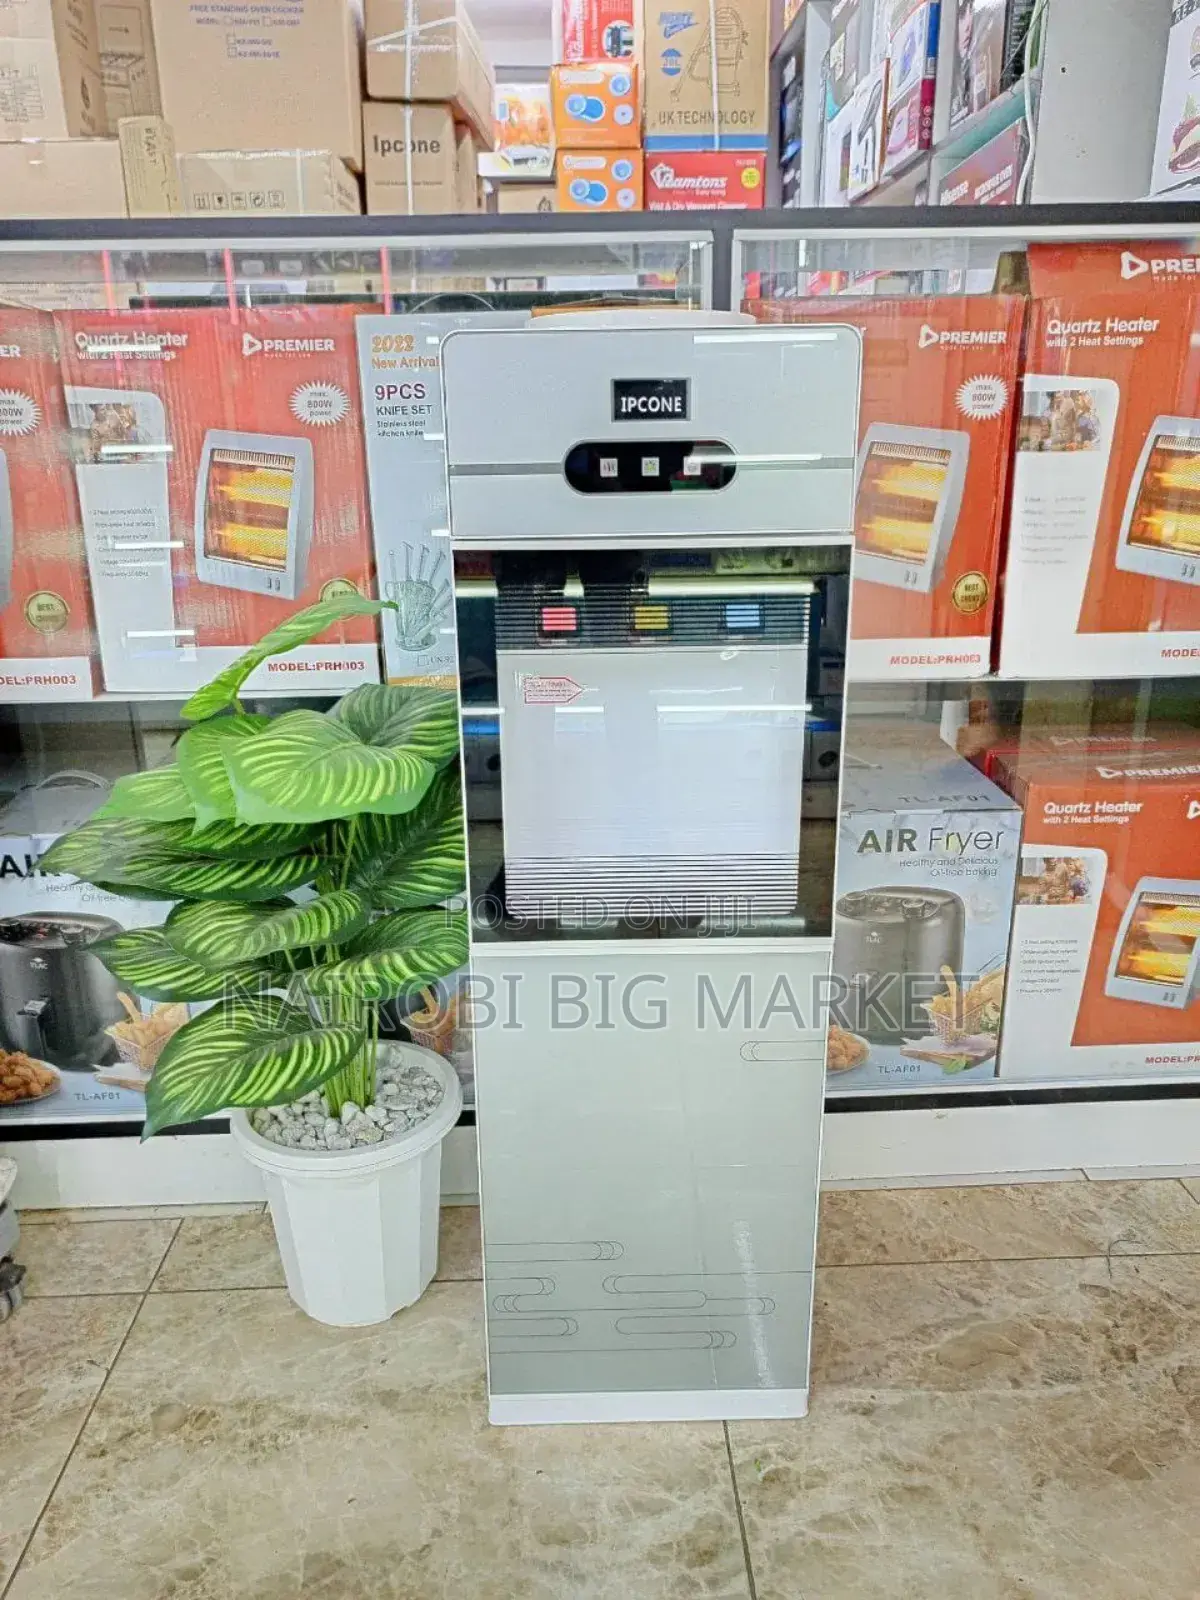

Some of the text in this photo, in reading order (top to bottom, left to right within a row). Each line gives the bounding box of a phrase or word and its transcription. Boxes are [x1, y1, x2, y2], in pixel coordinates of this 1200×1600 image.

[659, 110, 756, 125] UK TECHNOLOGY
[373, 134, 441, 157] Ipcone
[1047, 317, 1160, 335] Quartz Heater
[75, 330, 188, 347] Quartz Heater
[940, 331, 1008, 344] PREMIER
[1046, 334, 1144, 348] with 2 Heat Settings
[263, 338, 336, 352] PREMIER
[371, 354, 440, 369] New Arrival
[375, 383, 426, 401] 9PCS
[376, 404, 433, 416] KNIFE SET
[620, 395, 683, 414] IPCONE
[267, 661, 365, 672] MODEL:PRH003
[1043, 800, 1144, 815] Quartz Heater
[1042, 814, 1130, 825] with 2 Heat Settings
[857, 826, 1005, 856] AIR Fryer
[900, 856, 999, 868] Healthy and Delicious
[877, 1064, 921, 1075] TL-AF01
[74, 1092, 120, 1102] TL-AF01
